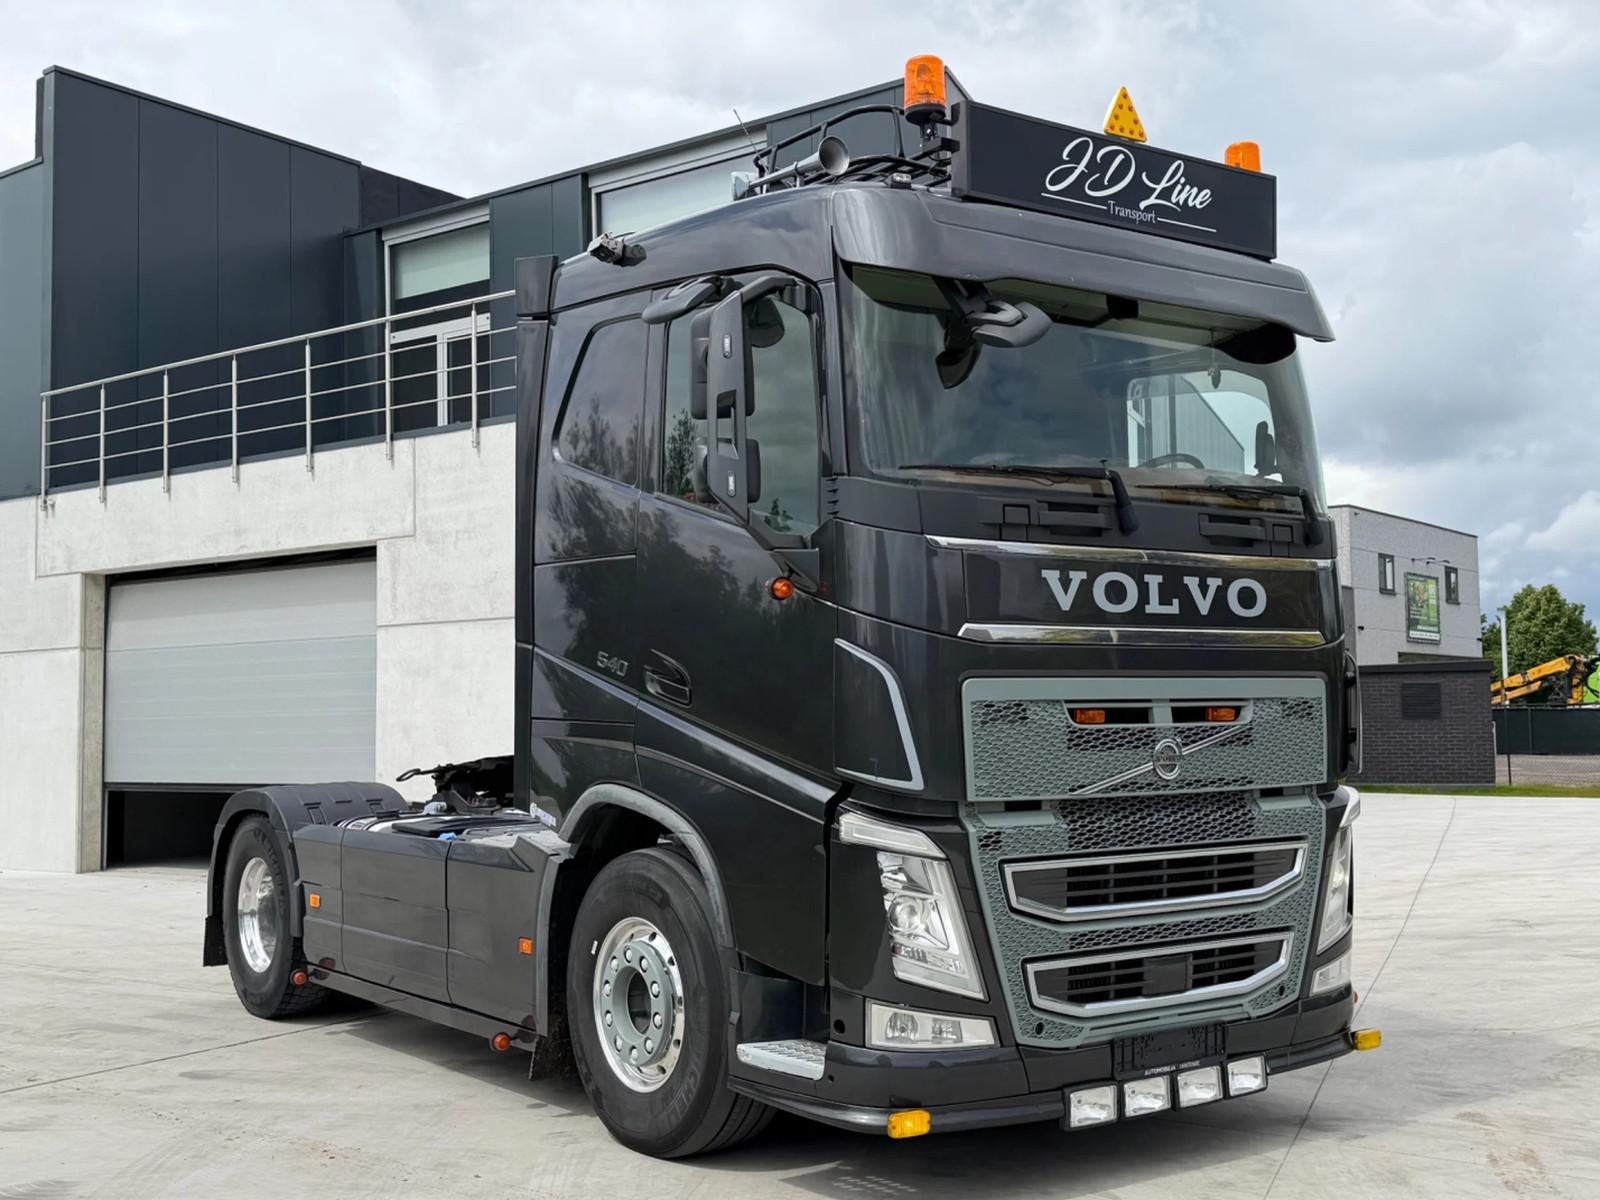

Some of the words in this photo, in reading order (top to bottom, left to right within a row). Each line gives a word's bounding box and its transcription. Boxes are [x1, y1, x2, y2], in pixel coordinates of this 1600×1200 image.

[1139, 160, 1213, 211] Line
[1107, 200, 1156, 224] Transport
[1041, 569, 1268, 618] VOLVO
[596, 650, 629, 677] 540
